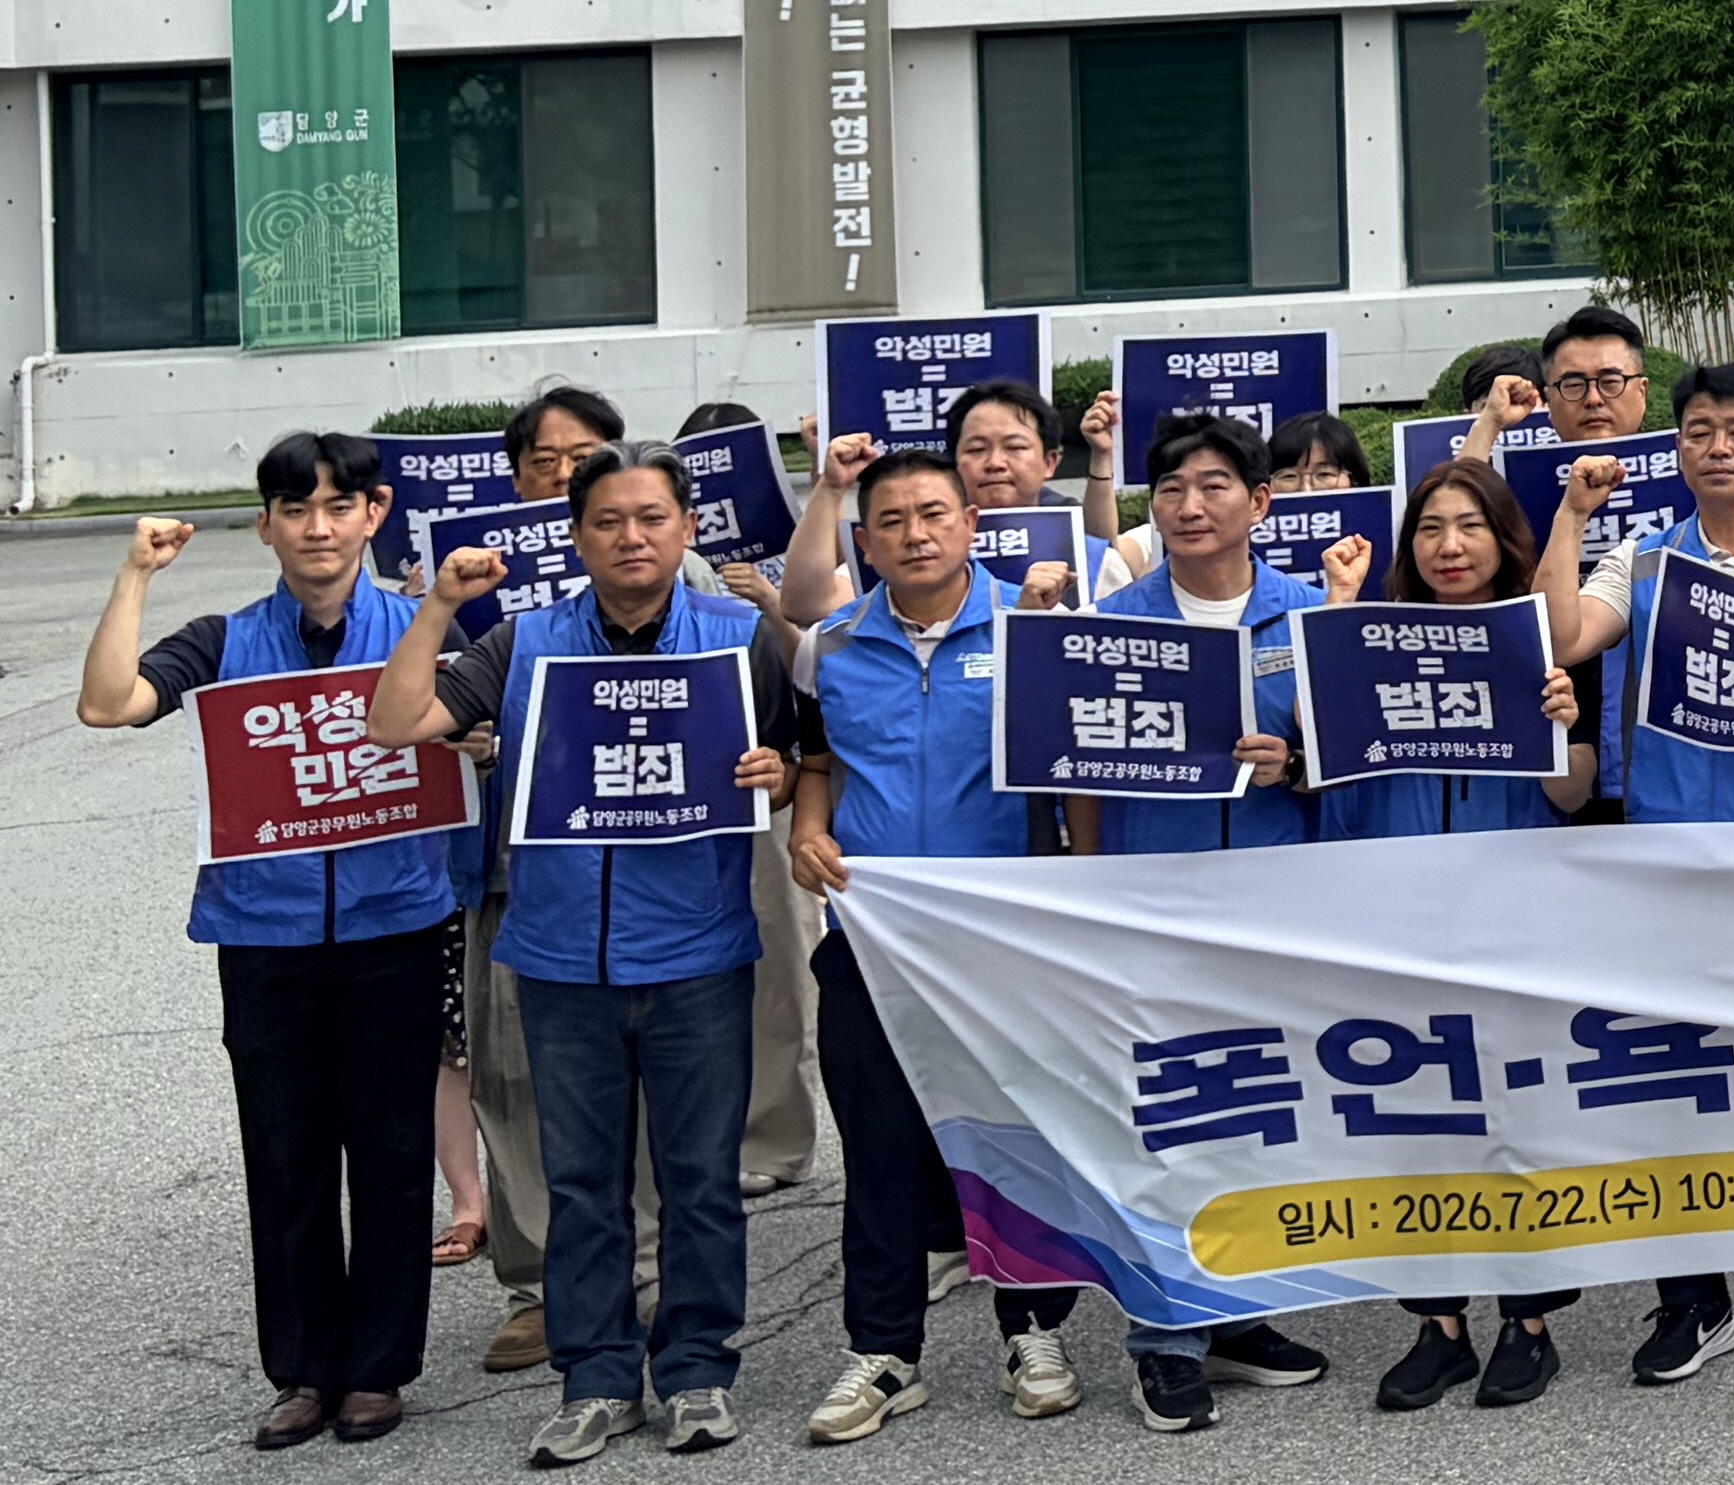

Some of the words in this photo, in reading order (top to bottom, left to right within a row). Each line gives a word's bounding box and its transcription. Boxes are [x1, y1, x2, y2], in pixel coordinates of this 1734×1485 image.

[829, 0, 867, 52] 는
[296, 130, 343, 145] DAMYANG
[345, 129, 369, 142] GUN
[875, 332, 993, 361] 악성민원
[1167, 349, 1280, 379] 악성민원
[688, 498, 742, 547] 죄
[1250, 509, 1342, 545] 성민원
[969, 527, 1030, 559] 민원
[1063, 634, 1191, 672] 악성민원
[1361, 622, 1491, 654] 악성민원
[593, 678, 689, 712] 악성민원
[1375, 680, 1494, 731] 범죄
[1069, 696, 1186, 752] 범죄
[1390, 740, 1514, 760] 담양군공무원노동조합
[291, 742, 420, 806] 민원
[593, 743, 687, 797] 범죄
[1077, 759, 1203, 783] 담양군공무원노동조합
[281, 803, 419, 839] 담양군공무원노동조합
[593, 804, 708, 829] 담양군공무원노동조합
[1278, 1196, 1355, 1247] 일시
[1370, 1202, 1380, 1230] :
[1392, 1174, 1662, 1235] 2026.7.22.(수)
